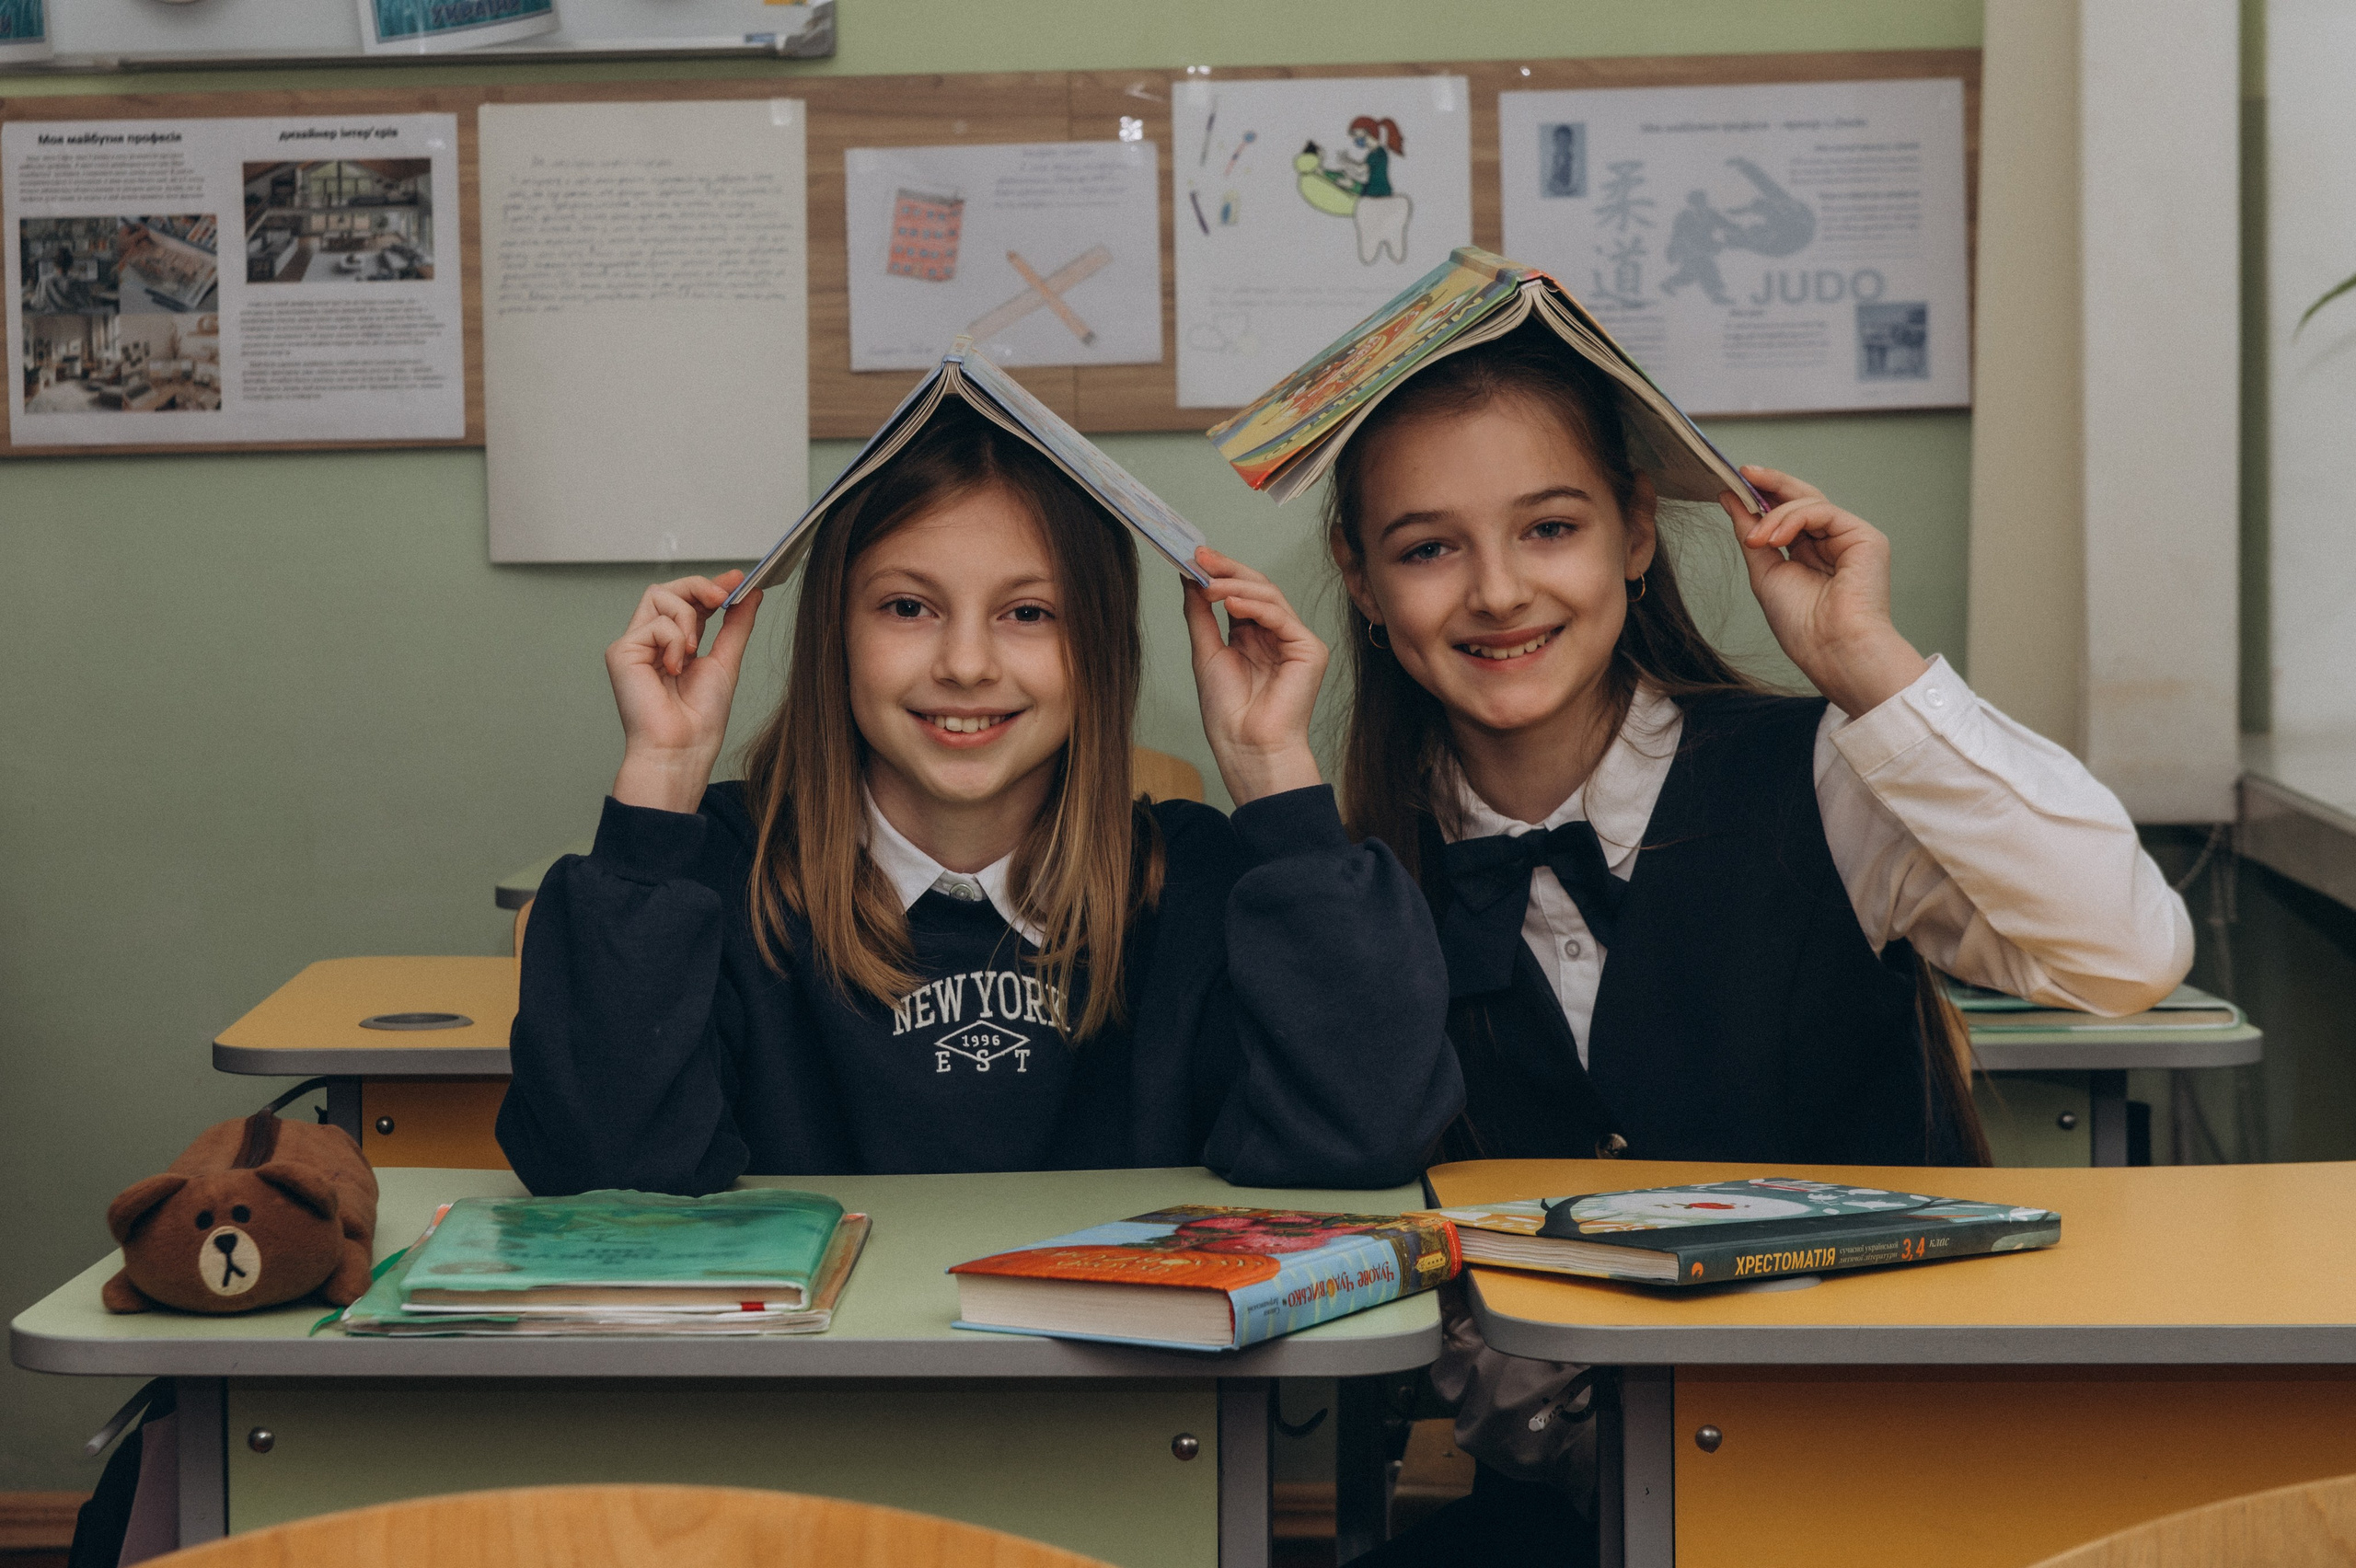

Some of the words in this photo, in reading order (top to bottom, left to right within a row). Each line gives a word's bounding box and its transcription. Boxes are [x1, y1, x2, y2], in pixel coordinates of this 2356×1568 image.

[38, 134, 64, 145] Моя
[67, 132, 124, 145] майбутня
[1750, 269, 1885, 305] JUDO
[1265, 296, 1484, 460] Мистецтво
[893, 973, 966, 1036] NEW
[961, 1034, 1000, 1047] 1996
[1928, 1238, 1950, 1249] клас
[1735, 1247, 1836, 1276] ХРЕСТОМАТІЯ
